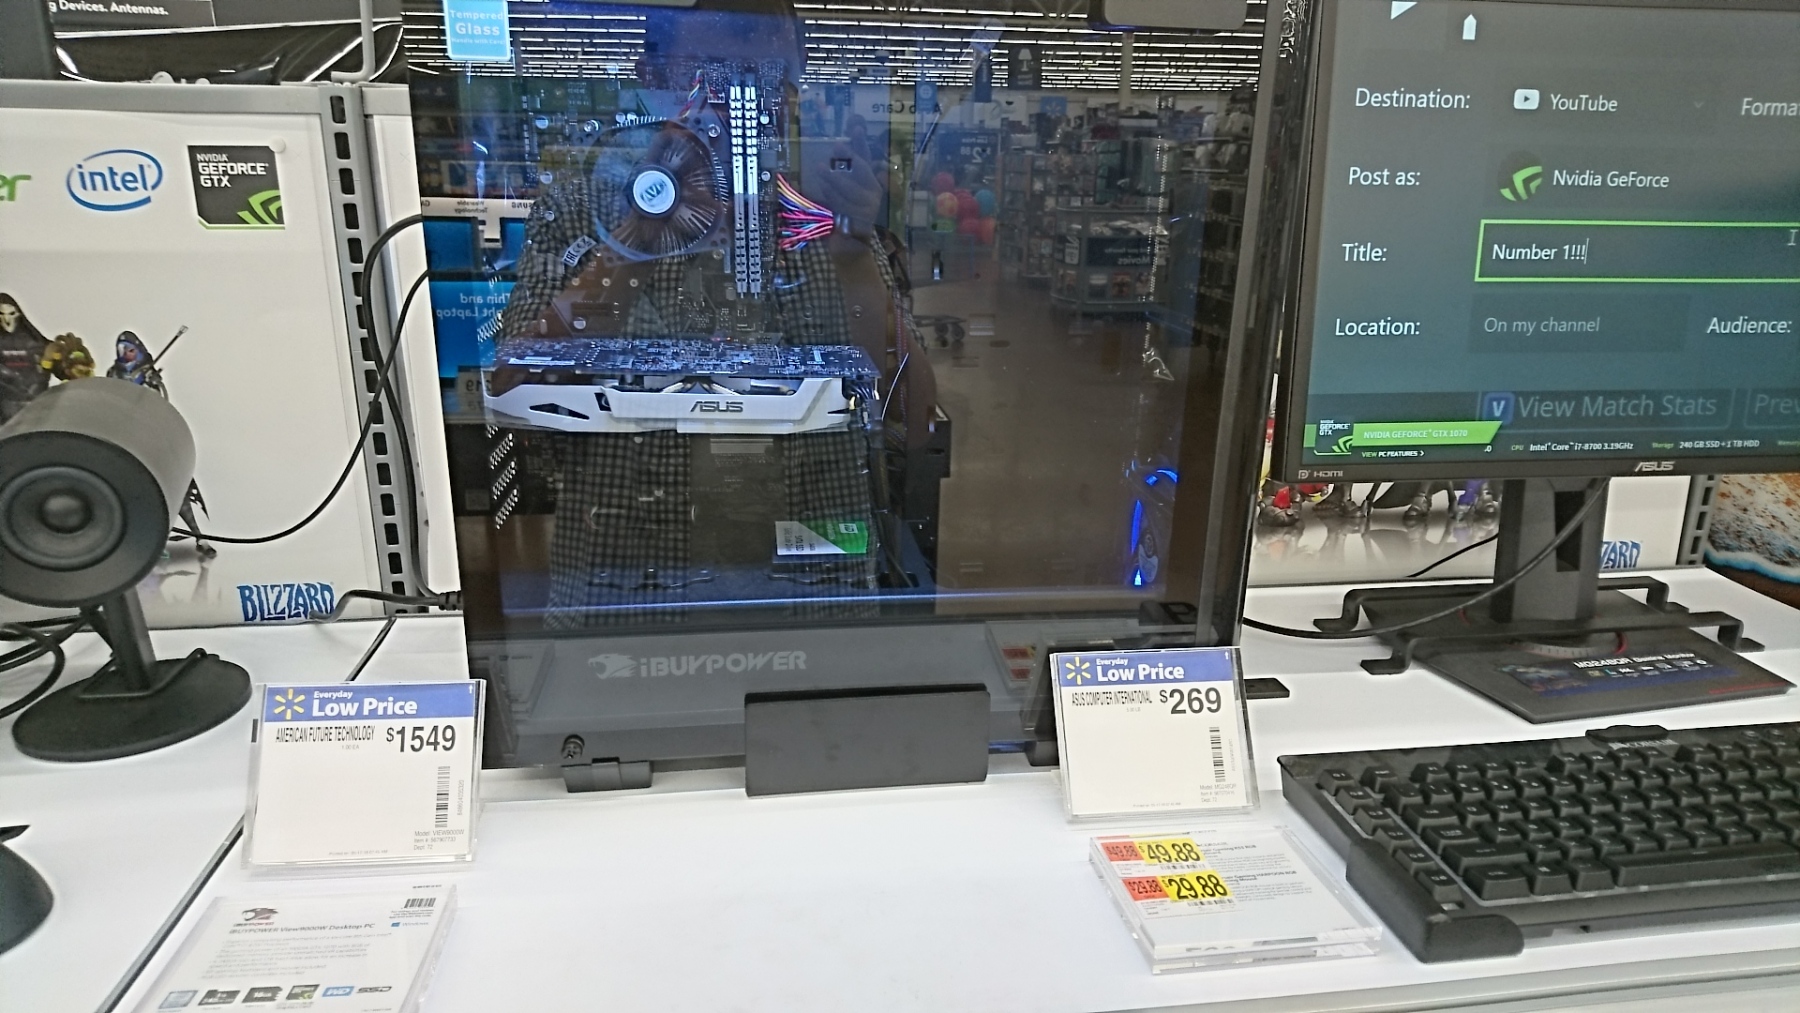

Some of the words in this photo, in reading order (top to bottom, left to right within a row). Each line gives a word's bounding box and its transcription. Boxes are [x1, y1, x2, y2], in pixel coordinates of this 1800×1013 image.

[60, 0, 108, 12] Devices.
[110, 2, 169, 15] Antennas.
[449, 10, 503, 20] Tempered
[455, 22, 500, 36] Glass
[1355, 88, 1471, 109] Destination:
[1550, 93, 1618, 112] YouTube
[196, 153, 228, 161] NVIDIA
[198, 162, 267, 175] GEFORCE
[76, 164, 148, 192] intel
[200, 175, 232, 187] GTX
[1348, 166, 1390, 186] Post
[1395, 170, 1421, 186] as:
[1553, 169, 1602, 187] Nvidia
[1607, 171, 1670, 188] GeForce
[1342, 243, 1387, 262] Title:
[1492, 243, 1557, 261] Number
[1335, 317, 1421, 337] Location:
[1484, 317, 1507, 333] On
[1511, 320, 1537, 338] my
[1540, 316, 1600, 333] channel
[1706, 317, 1792, 334] Audience:
[690, 401, 744, 413] ASUS
[1518, 396, 1575, 418] View
[1580, 395, 1654, 418] Match
[1660, 394, 1717, 416] Stats
[1364, 431, 1390, 439] NVIDIA
[1574, 442, 1602, 450] i7-8700
[1705, 440, 1719, 448] SSD
[1314, 470, 1344, 478] HDMI
[1635, 461, 1676, 472] ASUS
[236, 582, 335, 622] BLIZZARD
[640, 650, 807, 677] iBUYPOWER
[1096, 657, 1128, 666] Everyday
[1097, 665, 1135, 682] Low
[1138, 662, 1185, 680] Price
[314, 690, 353, 699] Everyday
[1113, 690, 1152, 704] INTERNATIONAL
[1159, 687, 1222, 714] $269
[312, 699, 359, 717] Low
[363, 696, 418, 716] Price
[276, 727, 308, 743] AMERICAN
[310, 726, 332, 742] FUTURE
[334, 726, 376, 741] TECHNOLOGY
[386, 724, 456, 753] $1549
[1106, 845, 1138, 858] $49.88
[1138, 842, 1201, 863] $49.88
[1128, 879, 1162, 894] $29.88
[1161, 874, 1228, 900] $29.88
